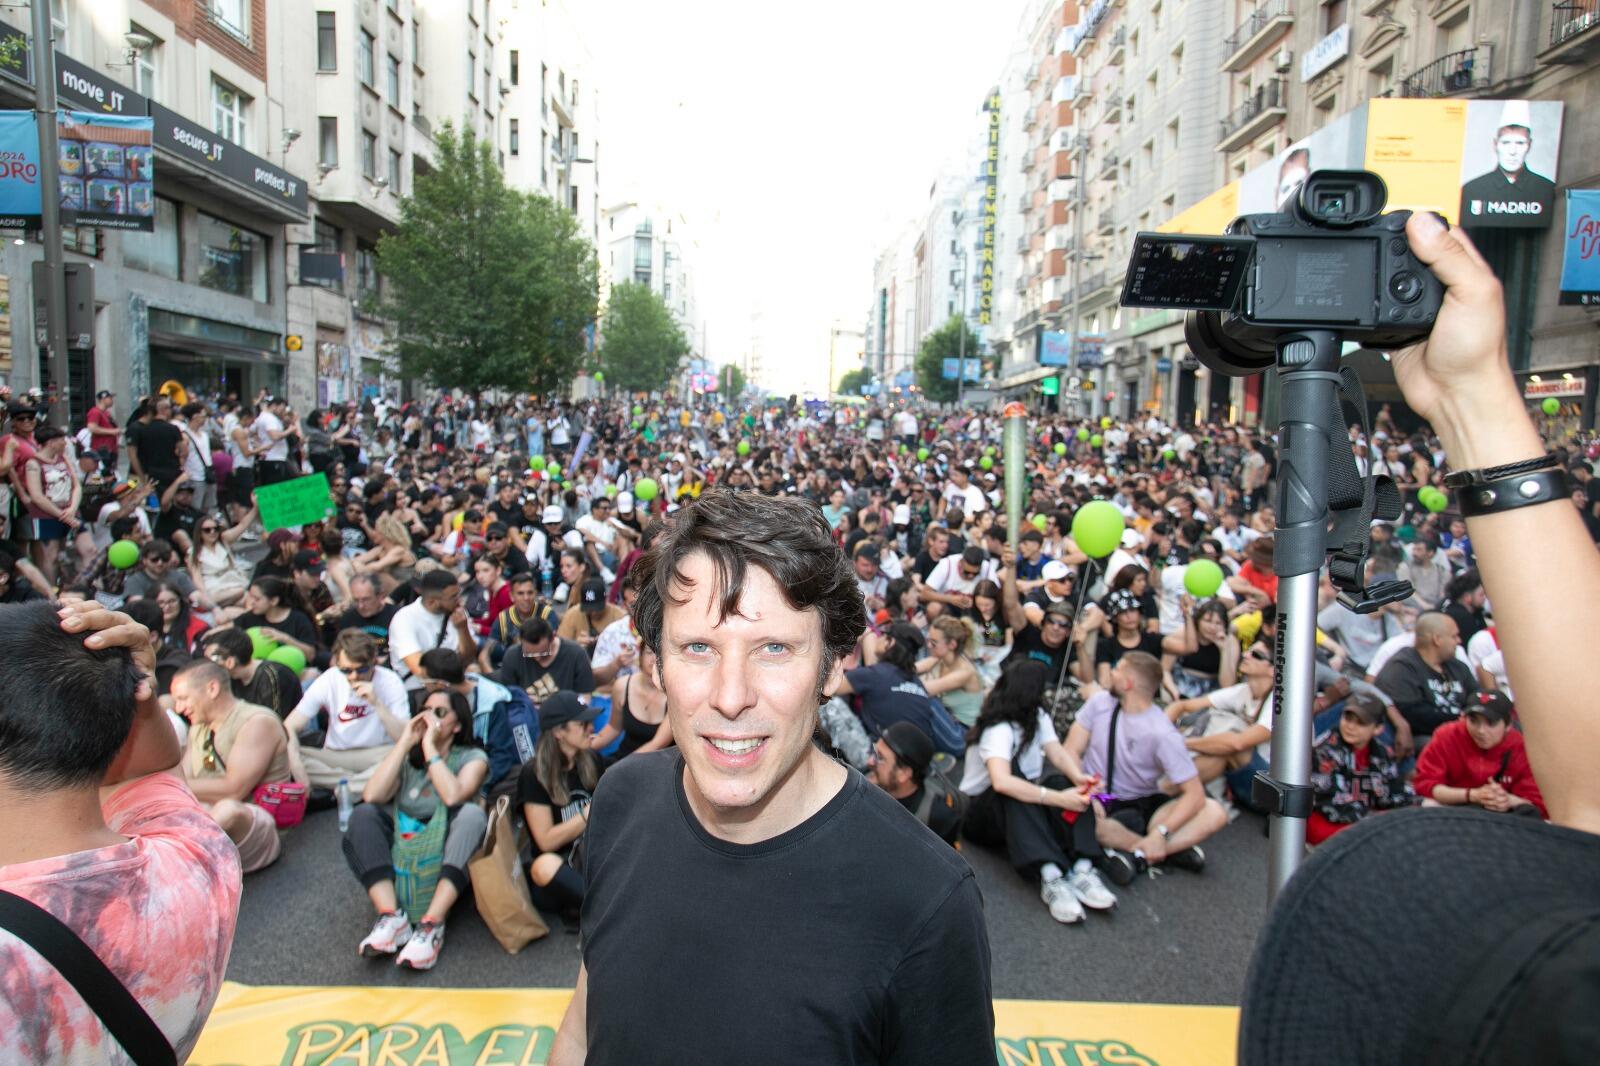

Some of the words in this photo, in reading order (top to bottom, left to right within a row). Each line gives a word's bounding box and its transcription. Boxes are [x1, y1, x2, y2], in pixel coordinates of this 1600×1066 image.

[986, 95, 1000, 177] HOTEL
[1487, 201, 1542, 214] MADRID
[1569, 214, 1600, 238] SA
[980, 185, 997, 325] EMPERADOR
[1275, 612, 1287, 716] Manfrotto
[344, 703, 369, 717] NIKE
[291, 1021, 452, 1066] PARA
[472, 1028, 552, 1066] EL
